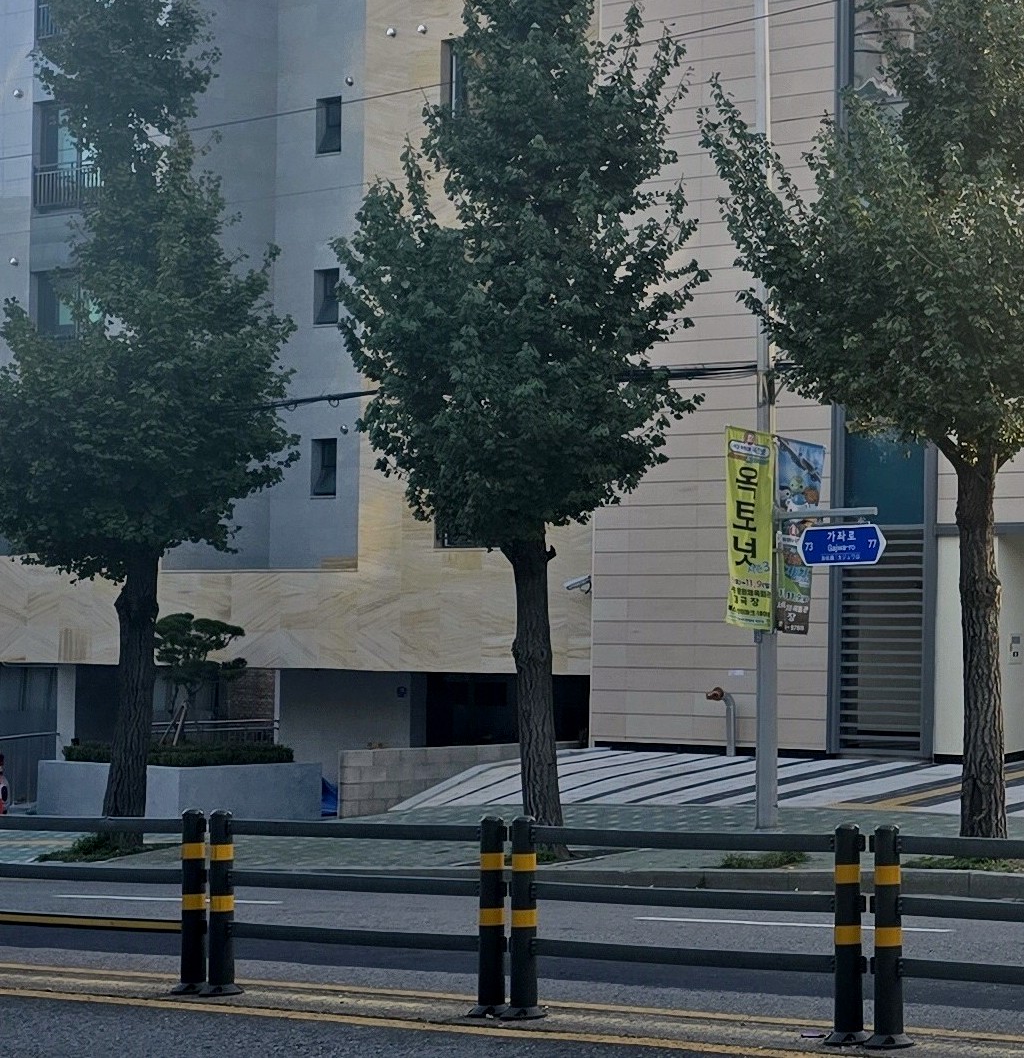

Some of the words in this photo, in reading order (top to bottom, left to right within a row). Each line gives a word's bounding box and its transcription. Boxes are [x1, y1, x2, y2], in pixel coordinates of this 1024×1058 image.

[732, 466, 758, 567] 옥토넛
[826, 530, 857, 542] 가좌로
[804, 541, 814, 552] 73
[867, 539, 877, 549] 77
